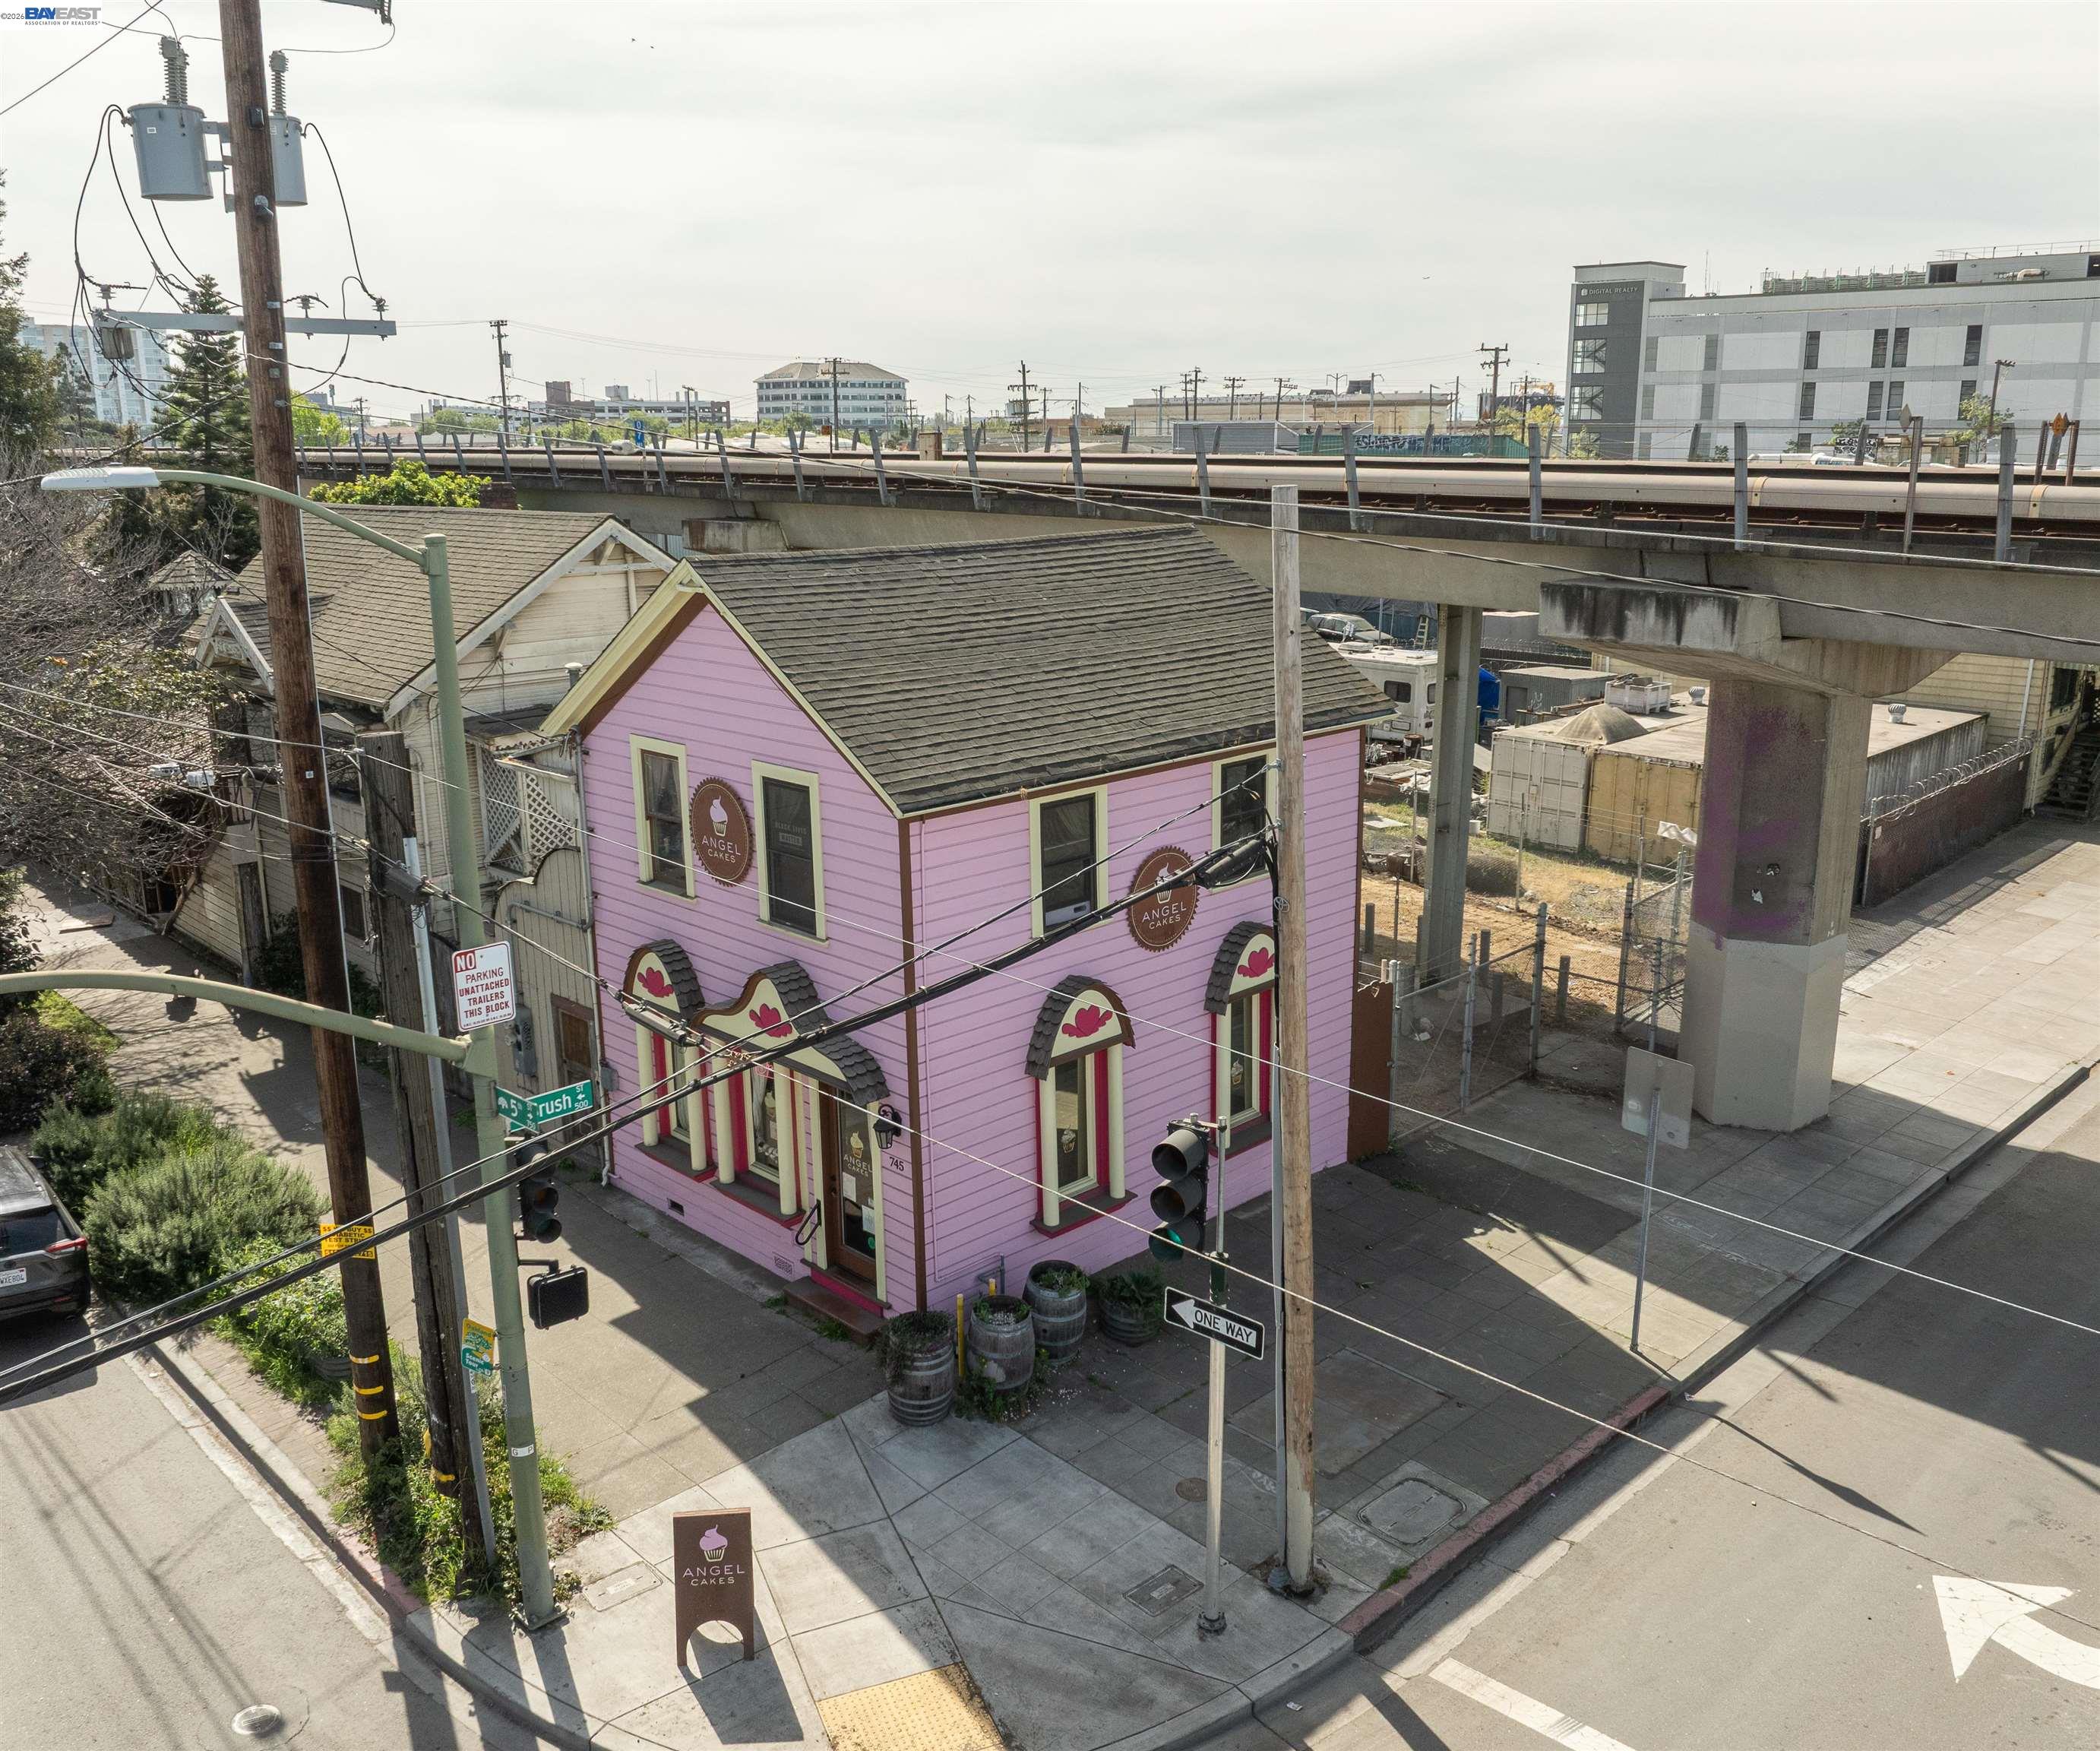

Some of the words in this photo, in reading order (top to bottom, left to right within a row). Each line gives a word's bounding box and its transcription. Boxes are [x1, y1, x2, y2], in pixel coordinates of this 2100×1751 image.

[702, 835, 741, 856] ANGEL
[707, 849, 736, 863] CAKES
[1142, 901, 1187, 923] ANGEL
[1149, 914, 1181, 929] CAKES
[456, 953, 476, 971] NO
[466, 967, 504, 984] PARKING
[459, 978, 509, 997] UNATTACHED
[468, 990, 504, 1006] TRAILERS
[464, 1007, 482, 1018] THIS
[485, 1001, 510, 1014] BLOCK
[536, 1094, 572, 1117] rush
[575, 1084, 584, 1093] ST
[574, 1100, 588, 1110] 500
[843, 1154, 872, 1173] ANGEL
[847, 1163, 868, 1177] CAKES
[889, 1156, 904, 1171] 745
[1194, 1309, 1220, 1331] ONE
[1226, 1321, 1253, 1343] WAY
[465, 1353, 485, 1364] Scenic
[465, 1358, 478, 1368] Tour
[682, 1564, 745, 1578] ANGEL
[691, 1576, 735, 1586] CAKES
